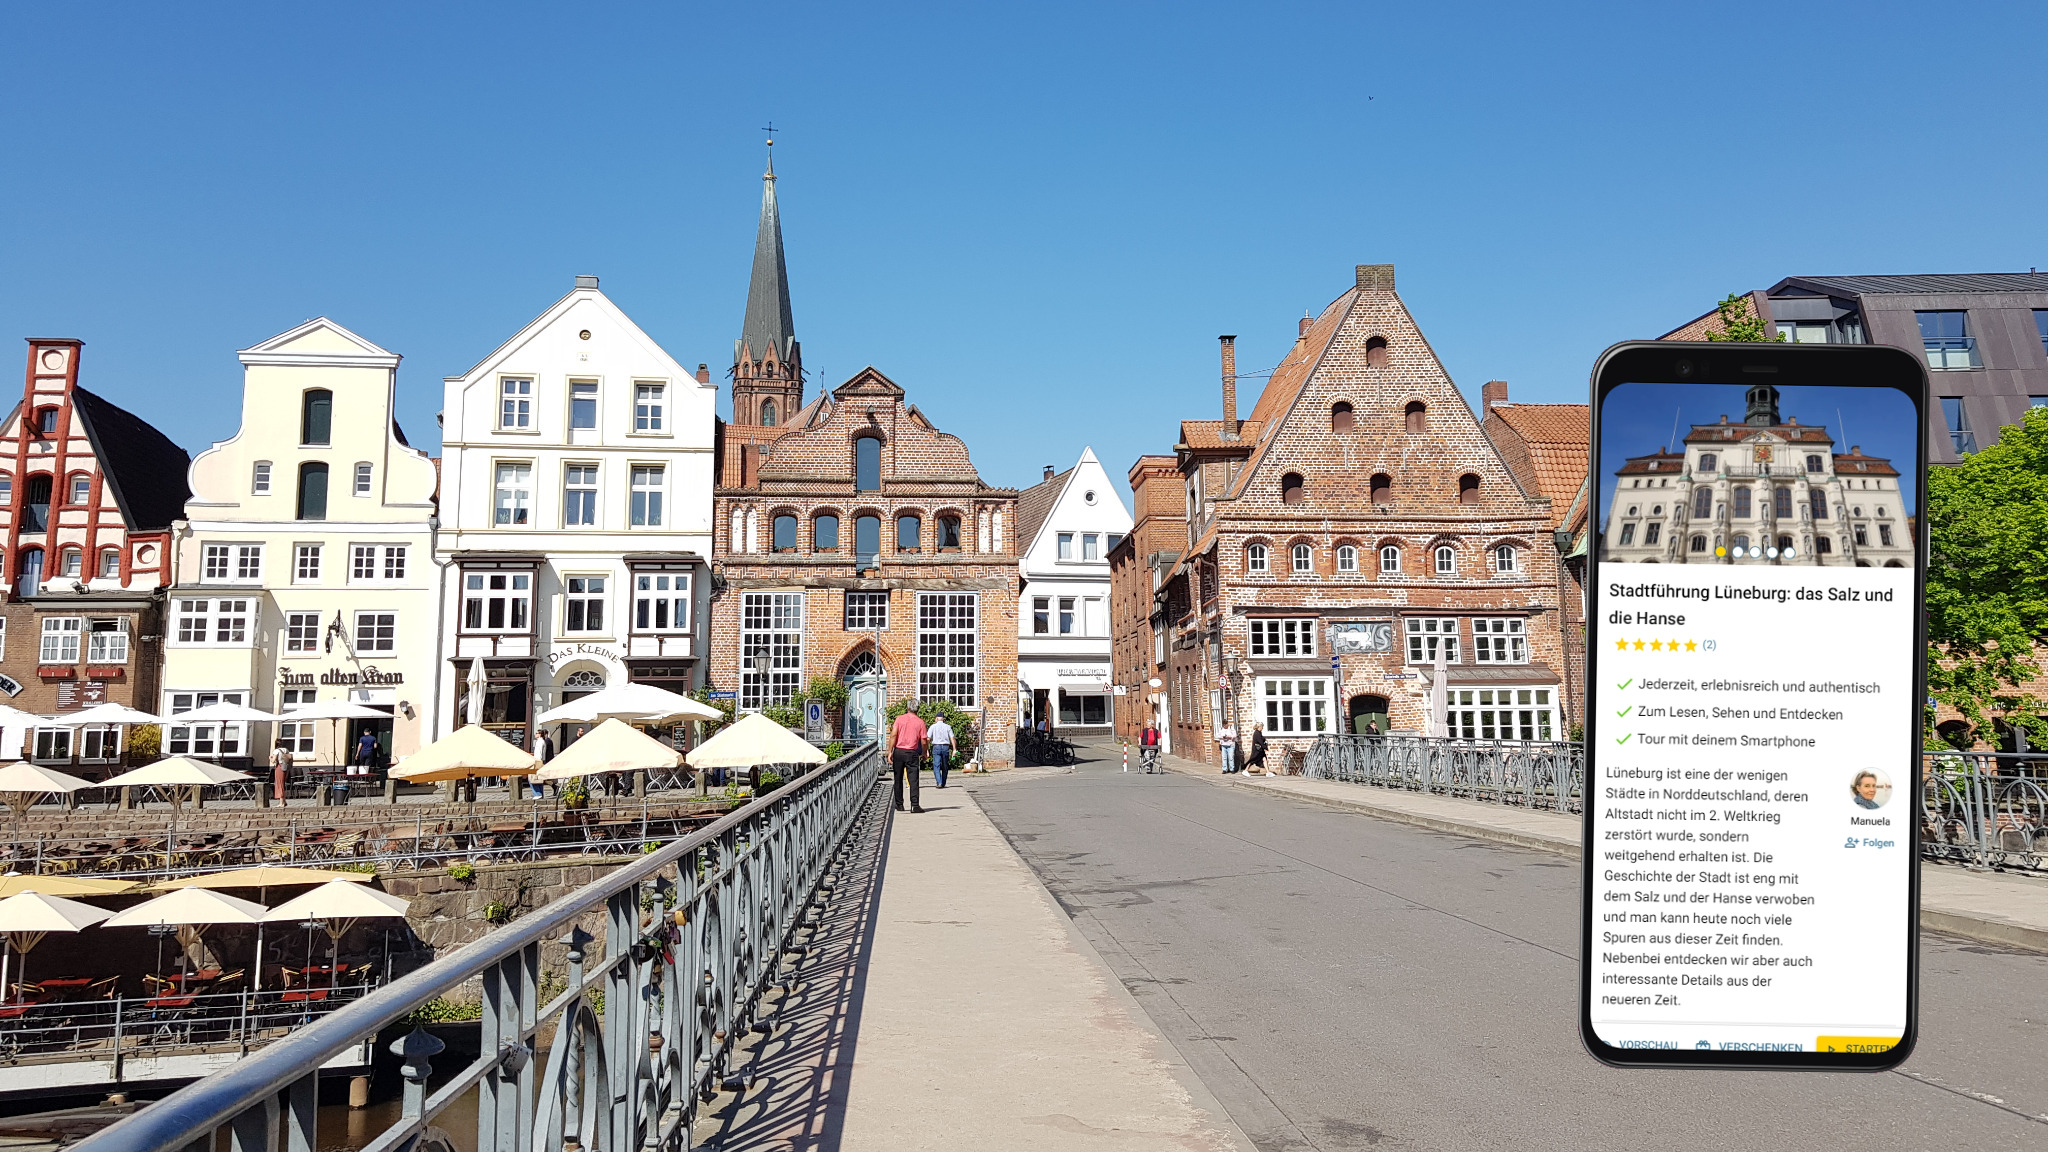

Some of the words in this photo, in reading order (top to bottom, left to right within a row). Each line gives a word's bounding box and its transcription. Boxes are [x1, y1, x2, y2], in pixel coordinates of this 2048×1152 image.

[1609, 583, 1710, 602] Stadtführung
[1714, 585, 1791, 604] Lüneburg:
[1795, 586, 1824, 601] das
[1827, 586, 1861, 602] Salz
[1864, 587, 1894, 603] und
[1608, 609, 1633, 625] die
[1636, 611, 1686, 626] Hanse
[1702, 639, 1717, 652] (2)
[547, 647, 573, 665] DAS
[576, 643, 621, 664] KLEINE
[278, 666, 315, 686] Zum
[320, 668, 359, 686] alten
[361, 665, 405, 686] Kran
[1638, 677, 1698, 692] Jederzeit,
[1700, 678, 1779, 692] erlebnisreich
[1782, 680, 1806, 693] und
[1808, 681, 1881, 694] authentisch
[1637, 705, 1666, 717] Zum
[1669, 706, 1709, 720] Lesen,
[1712, 706, 1750, 719] Sehen
[1753, 707, 1776, 719] und
[1779, 707, 1843, 721] Entdecken
[1637, 732, 1666, 745] Tour
[1668, 733, 1689, 746] mit
[1691, 733, 1737, 746] deinem
[1740, 734, 1816, 749] Smartphone
[1606, 766, 1663, 782] Lüneburg
[1666, 767, 1682, 780] ist
[1684, 768, 1711, 780] eine
[1713, 768, 1734, 781] der
[1736, 769, 1788, 784] wenigen
[1605, 787, 1646, 800] Städte
[1648, 788, 1660, 799] in
[1663, 788, 1771, 803] Norddeutschland,
[1773, 790, 1809, 803] deren
[1604, 807, 1654, 820] Altstadt
[1656, 809, 1687, 821] nicht
[1690, 809, 1706, 821] im
[1709, 809, 1720, 821] 2.
[1723, 809, 1781, 825] Weltkrieg
[1850, 816, 1891, 827] Manuela
[1604, 829, 1653, 841] zerstört
[1655, 829, 1696, 843] wurde,
[1699, 830, 1749, 843] sondern
[1863, 836, 1895, 851] Folgen
[1604, 849, 1676, 864] weitgehend
[1678, 850, 1729, 863] erhalten
[1731, 851, 1750, 863] ist.
[1753, 851, 1774, 864] Die
[1604, 869, 1673, 883] Geschichte
[1675, 870, 1696, 883] der
[1698, 871, 1731, 884] Stadt
[1734, 872, 1750, 884] ist
[1752, 874, 1776, 887] eng
[1779, 873, 1799, 885] mit
[1603, 890, 1631, 902] dem
[1634, 890, 1660, 903] Salz
[1663, 891, 1687, 903] und
[1689, 891, 1710, 904] der
[1712, 892, 1753, 905] Hanse
[1755, 893, 1815, 906] verwoben
[1603, 911, 1627, 923] und
[1629, 913, 1657, 923] man
[1660, 911, 1690, 924] kann
[1693, 912, 1728, 925] heute
[1730, 913, 1761, 925] noch
[1764, 913, 1793, 926] viele
[1602, 931, 1646, 945] Spuren
[1649, 934, 1672, 945] aus
[1674, 932, 1713, 945] dieser
[1715, 933, 1739, 946] Zeit
[1742, 933, 1783, 946] finden.
[1602, 952, 1661, 964] Nebenbei
[1663, 953, 1728, 966] entdecken
[1730, 954, 1750, 966] wir
[1752, 954, 1780, 967] aber
[1782, 955, 1813, 967] auch
[1602, 972, 1678, 986] interessante
[1681, 974, 1723, 987] Details
[1726, 977, 1749, 987] aus
[1751, 975, 1772, 987] der
[1601, 995, 1651, 1006] neueren
[1654, 994, 1681, 1006] Zeit.
[1618, 1040, 1679, 1050] VORSCHAU
[1718, 1041, 1804, 1053] VERSCHENKEN
